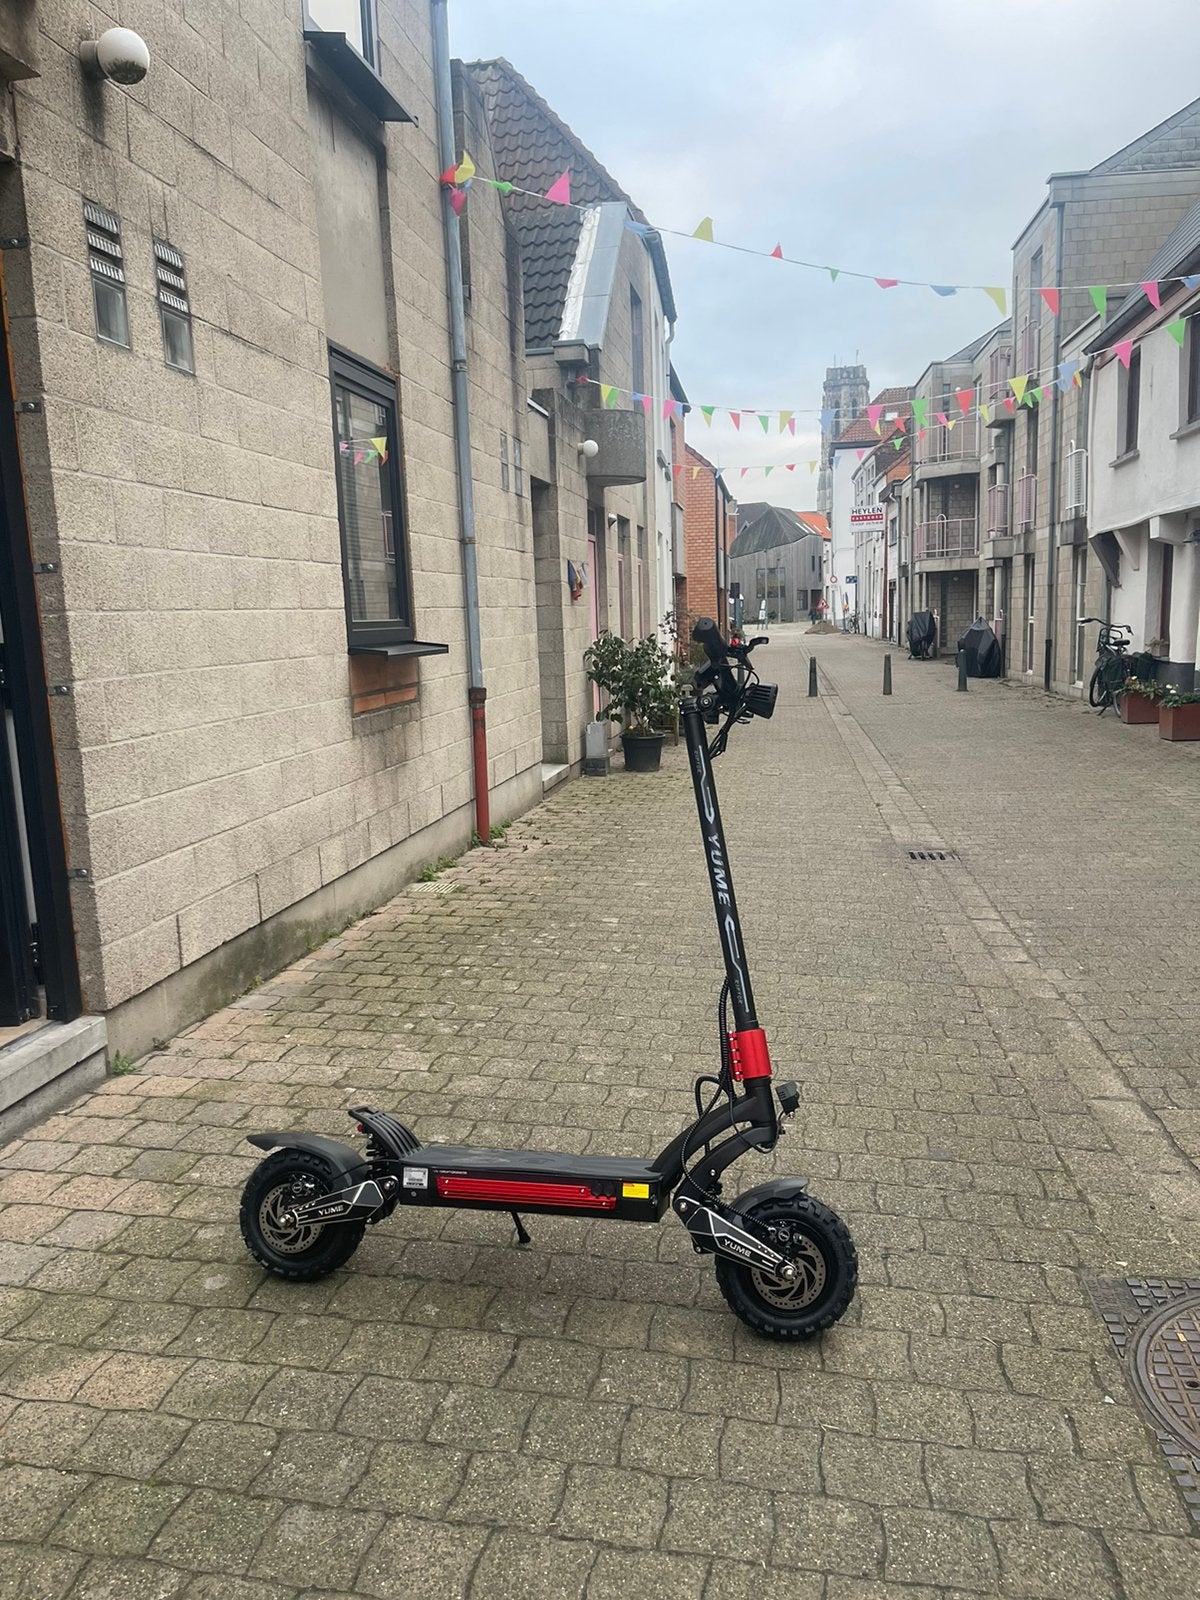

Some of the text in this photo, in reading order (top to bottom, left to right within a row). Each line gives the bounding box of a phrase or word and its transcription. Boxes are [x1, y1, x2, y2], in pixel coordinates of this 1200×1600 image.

[852, 506, 882, 515] HEYLEN
[708, 833, 732, 907] YUME
[318, 1204, 344, 1216] YUME
[724, 1239, 752, 1258] YUME
